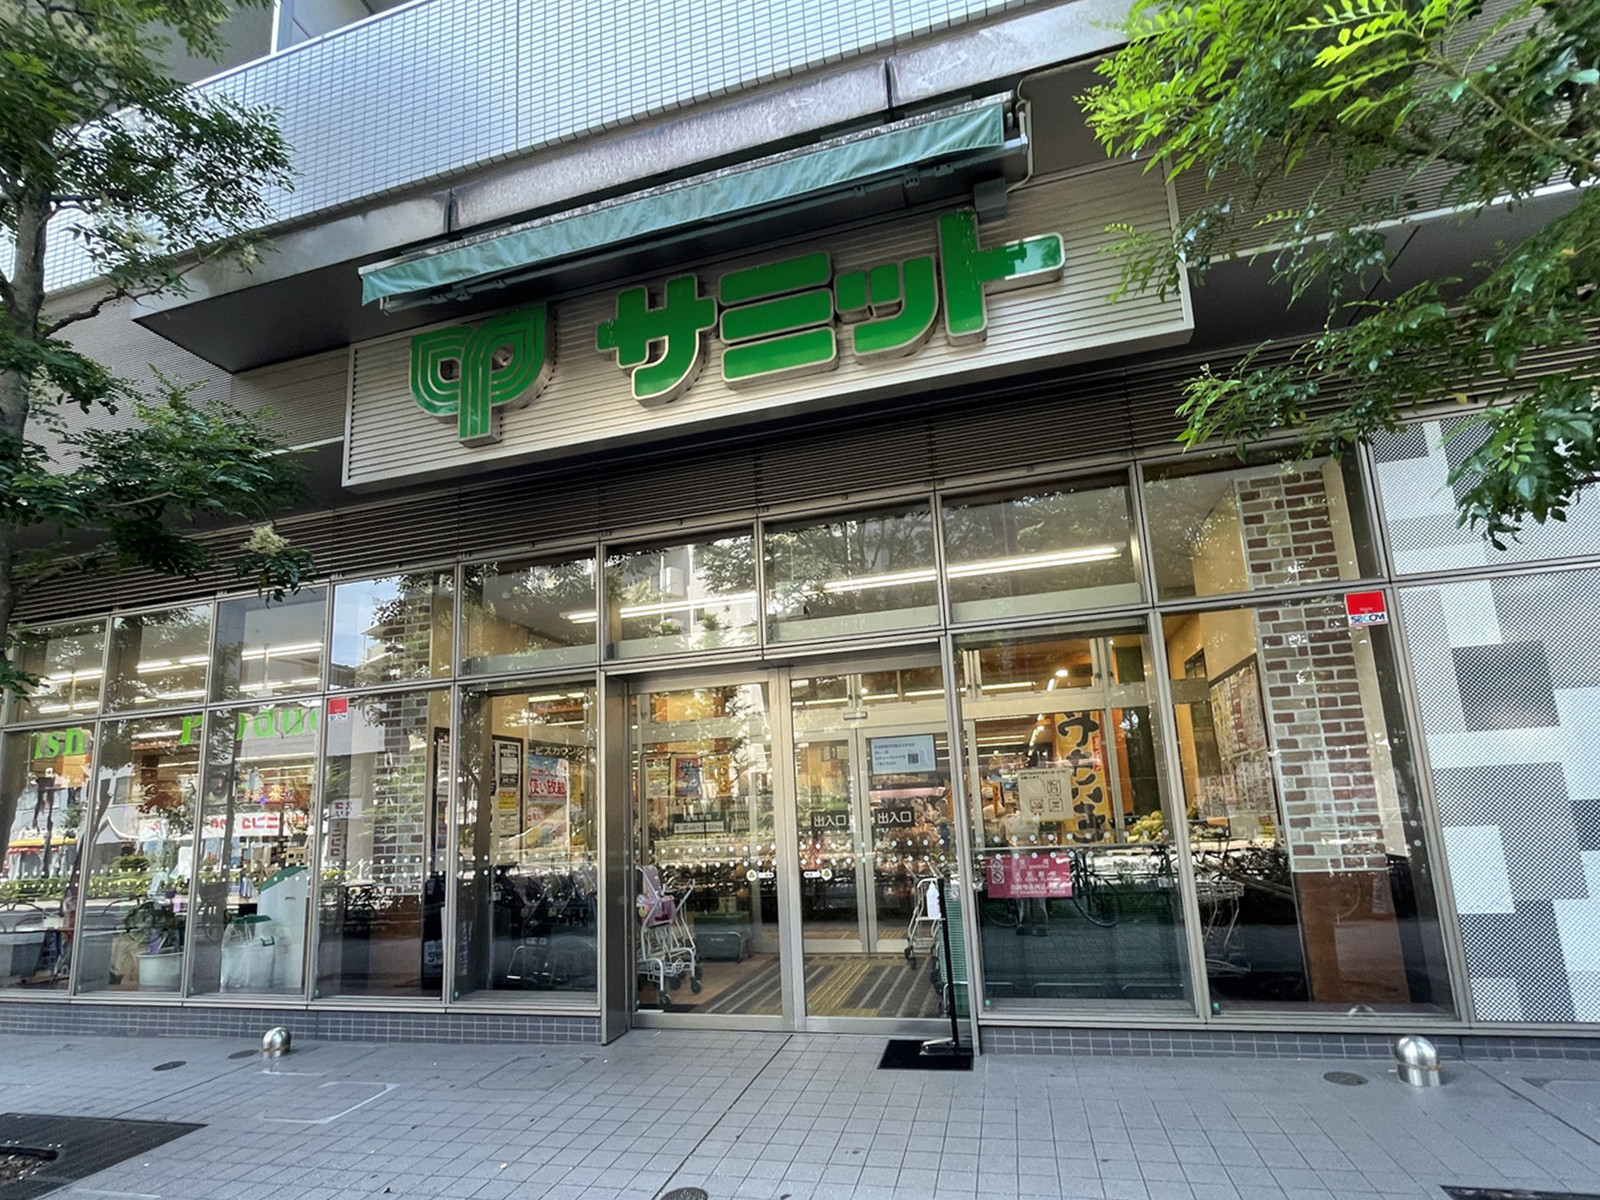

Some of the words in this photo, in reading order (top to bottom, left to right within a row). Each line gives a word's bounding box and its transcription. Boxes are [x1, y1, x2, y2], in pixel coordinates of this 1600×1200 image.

[597, 210, 1065, 401] サミット
[1350, 614, 1386, 624] SECOM
[528, 746, 586, 757] ービスカウンタ
[813, 814, 847, 828] 出入口
[877, 810, 912, 825] 出入口
